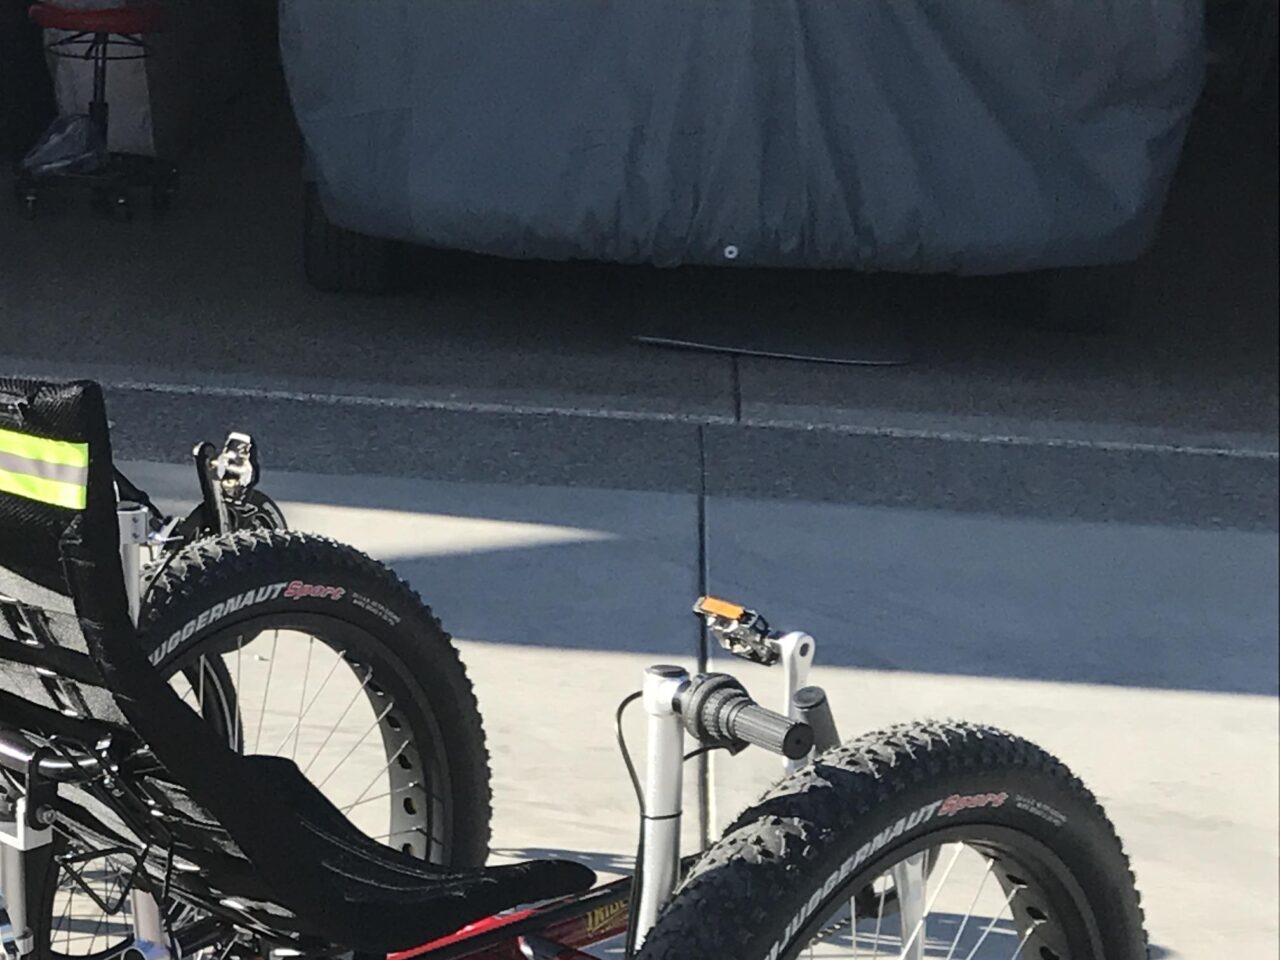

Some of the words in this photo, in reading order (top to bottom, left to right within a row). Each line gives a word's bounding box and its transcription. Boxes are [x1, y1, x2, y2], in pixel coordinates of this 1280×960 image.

[283, 580, 346, 600] Sport
[779, 800, 942, 953] JUGGERNAUT
[938, 792, 1009, 816] Sport
